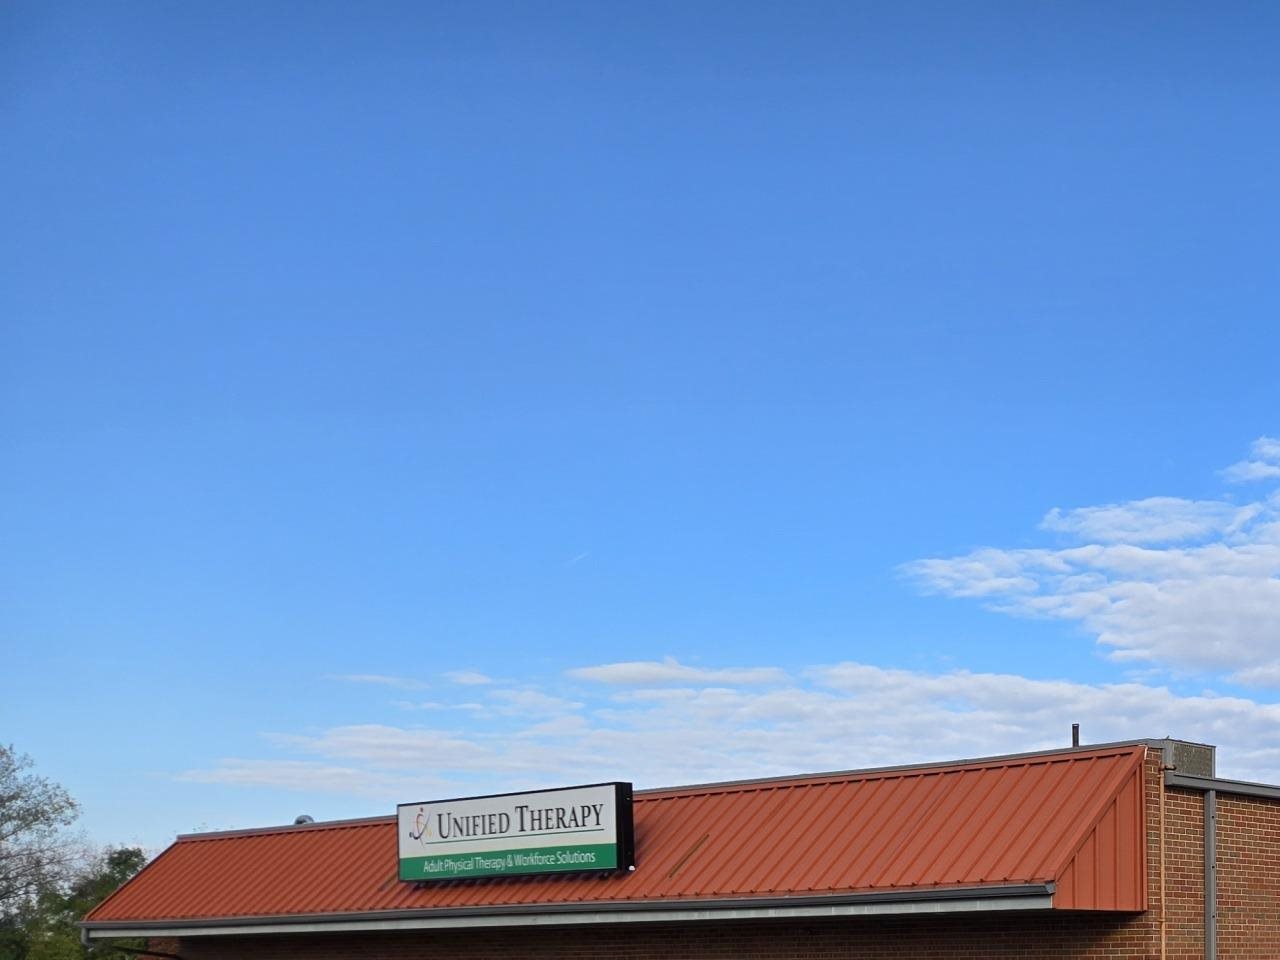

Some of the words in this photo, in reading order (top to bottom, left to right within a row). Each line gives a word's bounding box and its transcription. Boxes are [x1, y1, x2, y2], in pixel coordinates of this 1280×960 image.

[437, 812, 510, 839] UNIFIED
[515, 803, 604, 832] THERAPY
[423, 858, 444, 873] Adult
[444, 857, 474, 874] Physical
[473, 856, 506, 871] Therapy
[506, 854, 513, 867] &
[513, 851, 556, 866] Workforce
[556, 850, 596, 864] Solutions
